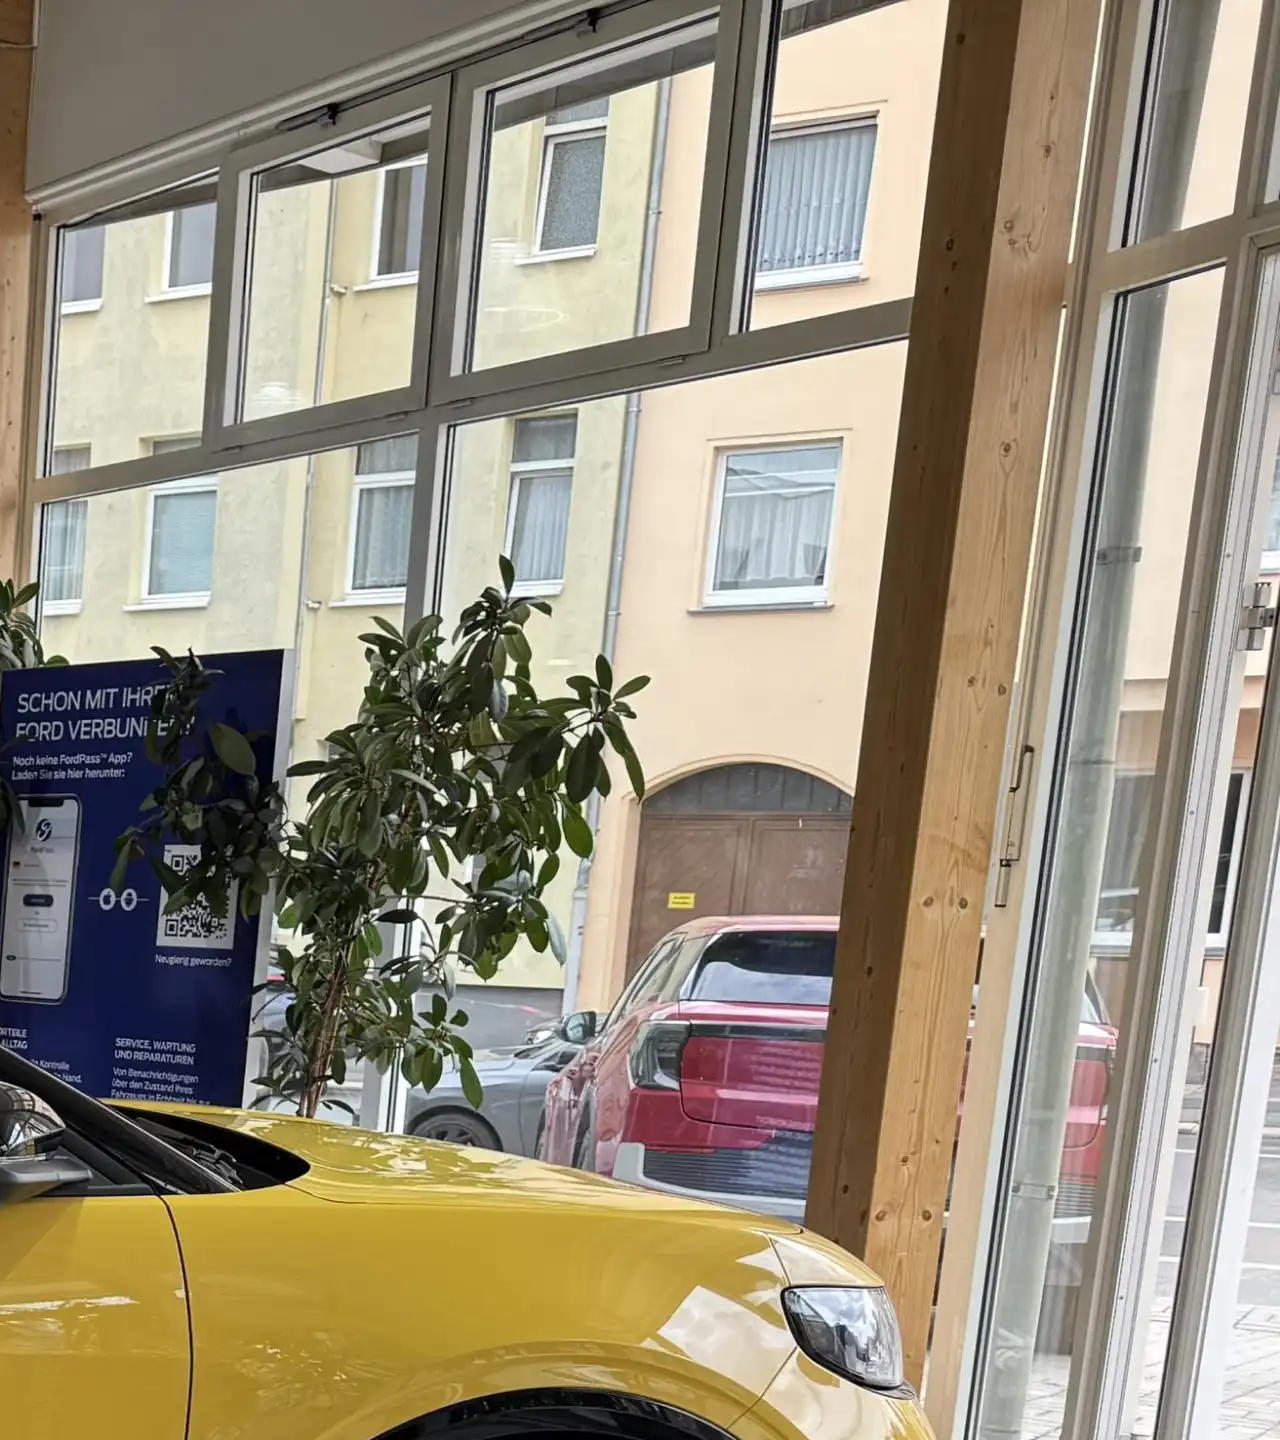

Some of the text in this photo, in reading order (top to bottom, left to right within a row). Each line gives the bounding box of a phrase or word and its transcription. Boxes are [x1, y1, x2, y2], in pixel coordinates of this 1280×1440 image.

[17, 683, 183, 713] SCHON MIT IHR
[15, 721, 64, 742] FORD
[13, 755, 35, 767] Noch
[36, 755, 58, 766] keine
[108, 752, 133, 765] App?
[12, 769, 38, 780] Laden
[53, 769, 66, 779] sie
[67, 768, 83, 779] hier
[85, 767, 125, 779] herunter:
[155, 954, 232, 968] Neugierig geworden?
[0, 1039, 28, 1050] ALLTAG
[115, 1037, 196, 1053] SERVICE, WARTUNG
[114, 1049, 195, 1065] UND REPARATUREN
[40, 1059, 70, 1071] Kontrolle
[113, 1066, 199, 1084] Von Benachrichtigungen
[129, 1080, 143, 1090] den
[144, 1081, 175, 1093] Zustand
